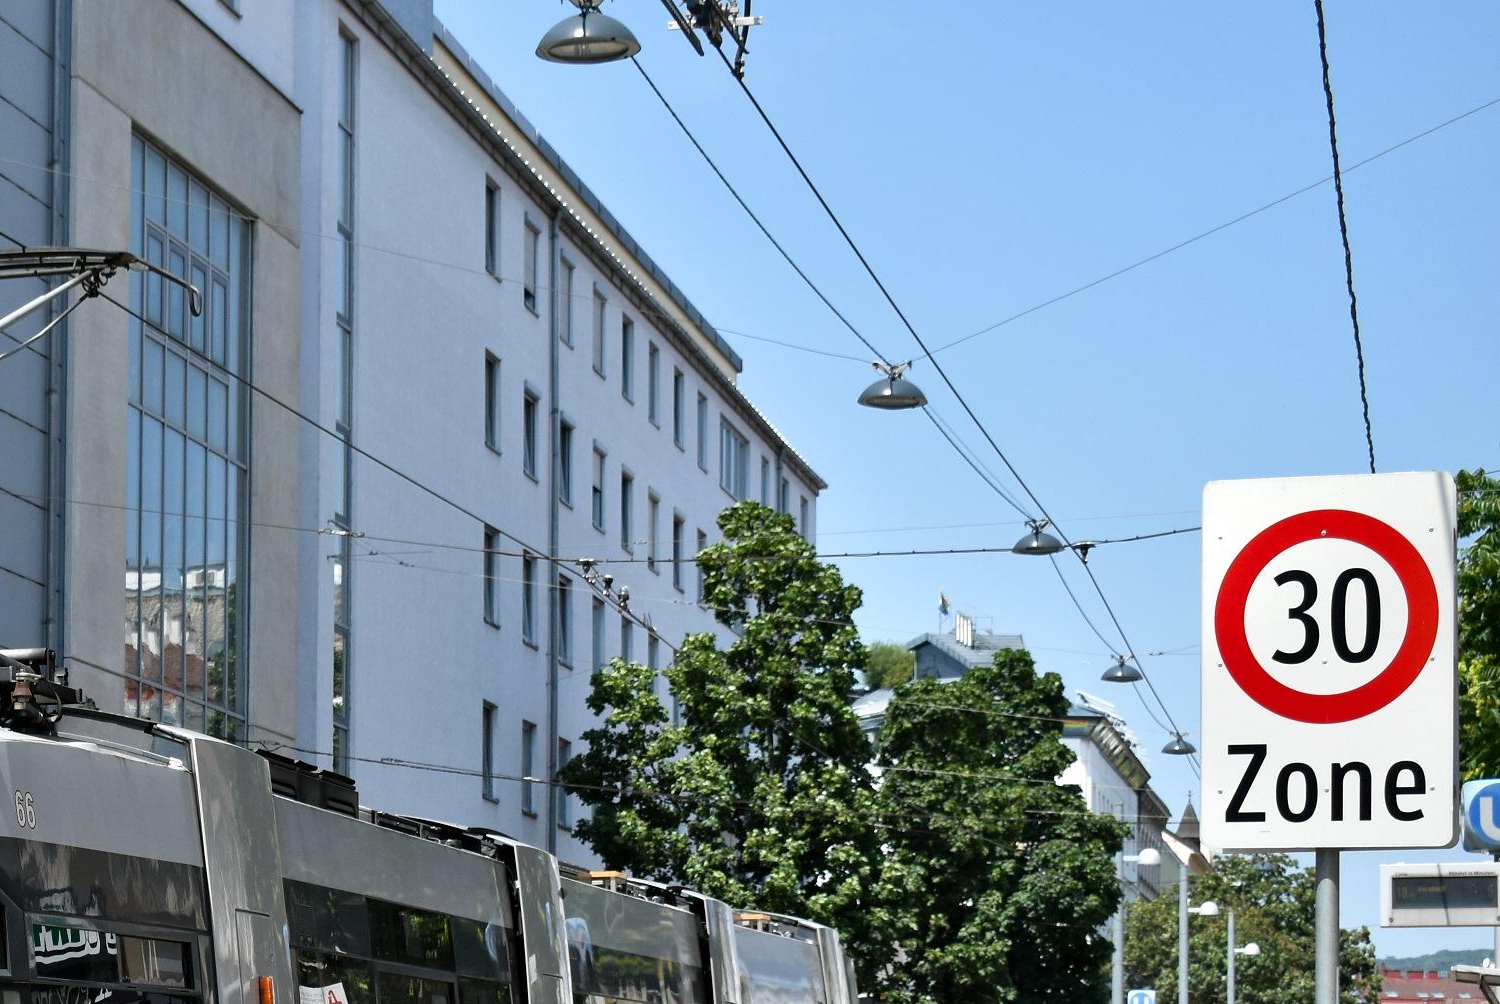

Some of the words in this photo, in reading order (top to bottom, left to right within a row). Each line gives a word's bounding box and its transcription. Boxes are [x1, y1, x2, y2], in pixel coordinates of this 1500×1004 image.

[1272, 568, 1381, 665] 30
[15, 790, 36, 829] 66
[1225, 743, 1426, 823] Zone
